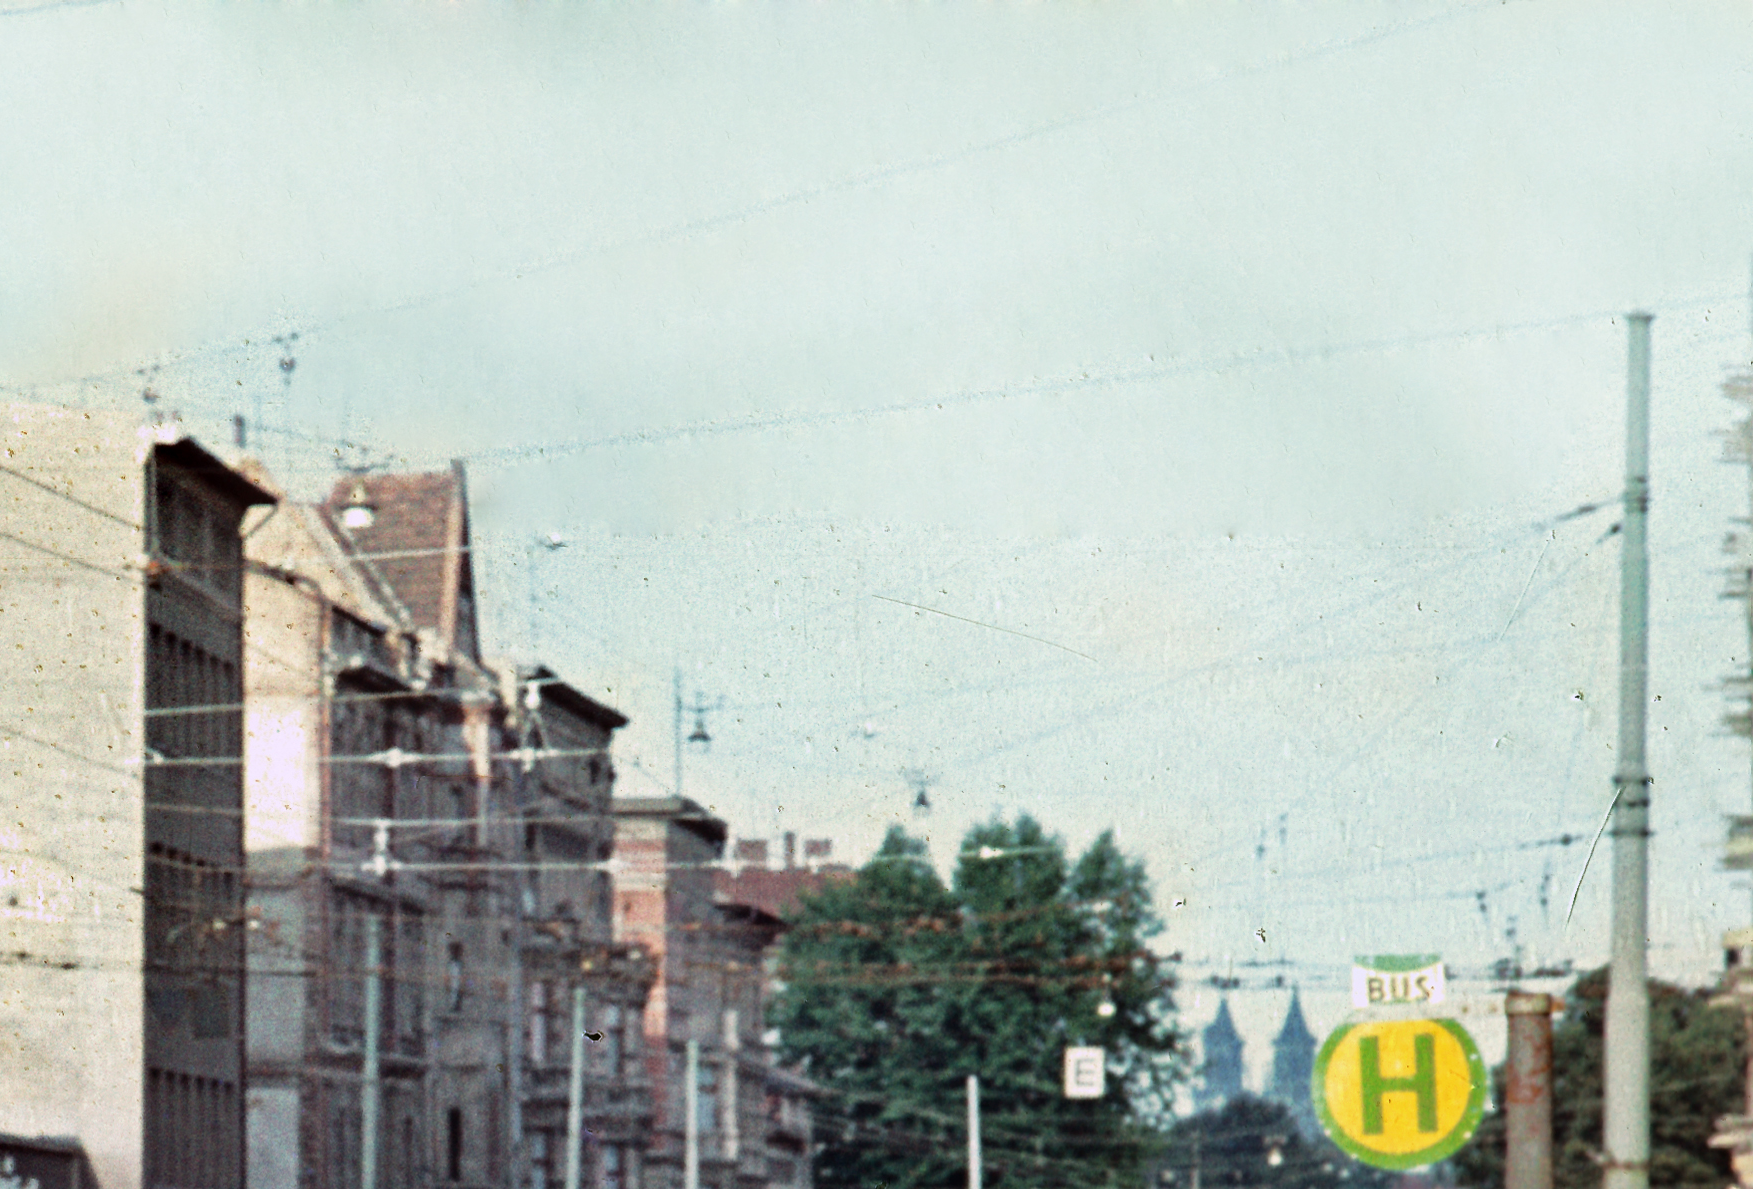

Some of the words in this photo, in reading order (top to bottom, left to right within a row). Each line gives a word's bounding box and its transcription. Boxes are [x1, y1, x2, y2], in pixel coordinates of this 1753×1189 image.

[1367, 976, 1430, 1003] BUS
[1074, 1058, 1095, 1087] E
[1359, 1033, 1439, 1136] H
